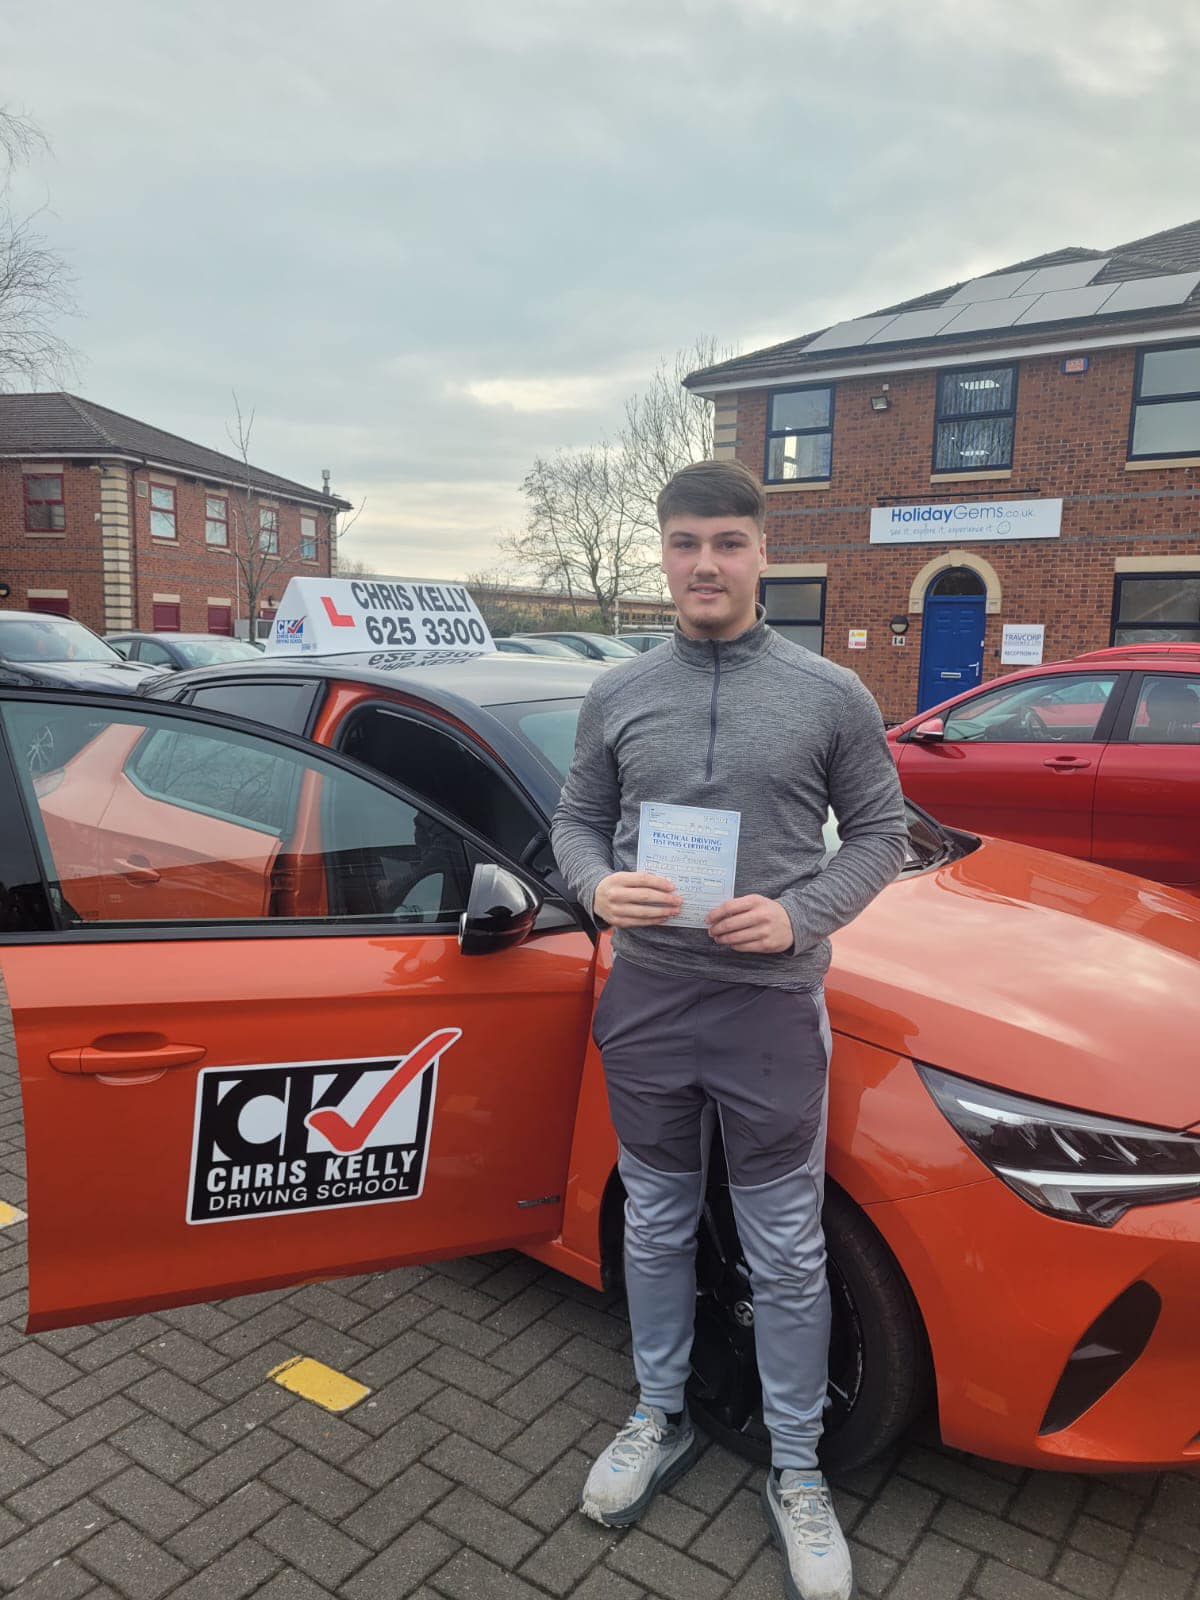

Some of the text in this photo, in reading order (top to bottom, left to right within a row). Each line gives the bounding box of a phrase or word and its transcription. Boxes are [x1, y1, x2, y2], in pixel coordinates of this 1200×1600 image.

[891, 505, 1033, 523] HolidayGems.co.uk
[320, 596, 356, 627] L
[351, 582, 472, 613] CHRIS KELLY
[366, 616, 486, 645] 625 3300
[894, 637, 904, 645] 14
[653, 832, 722, 846] PRACTICAL DRIVING
[683, 843, 721, 852] CERTIFICATE
[206, 1150, 418, 1192] CHRIS KELLY
[209, 1177, 409, 1211] DRIVING SCHOOL
